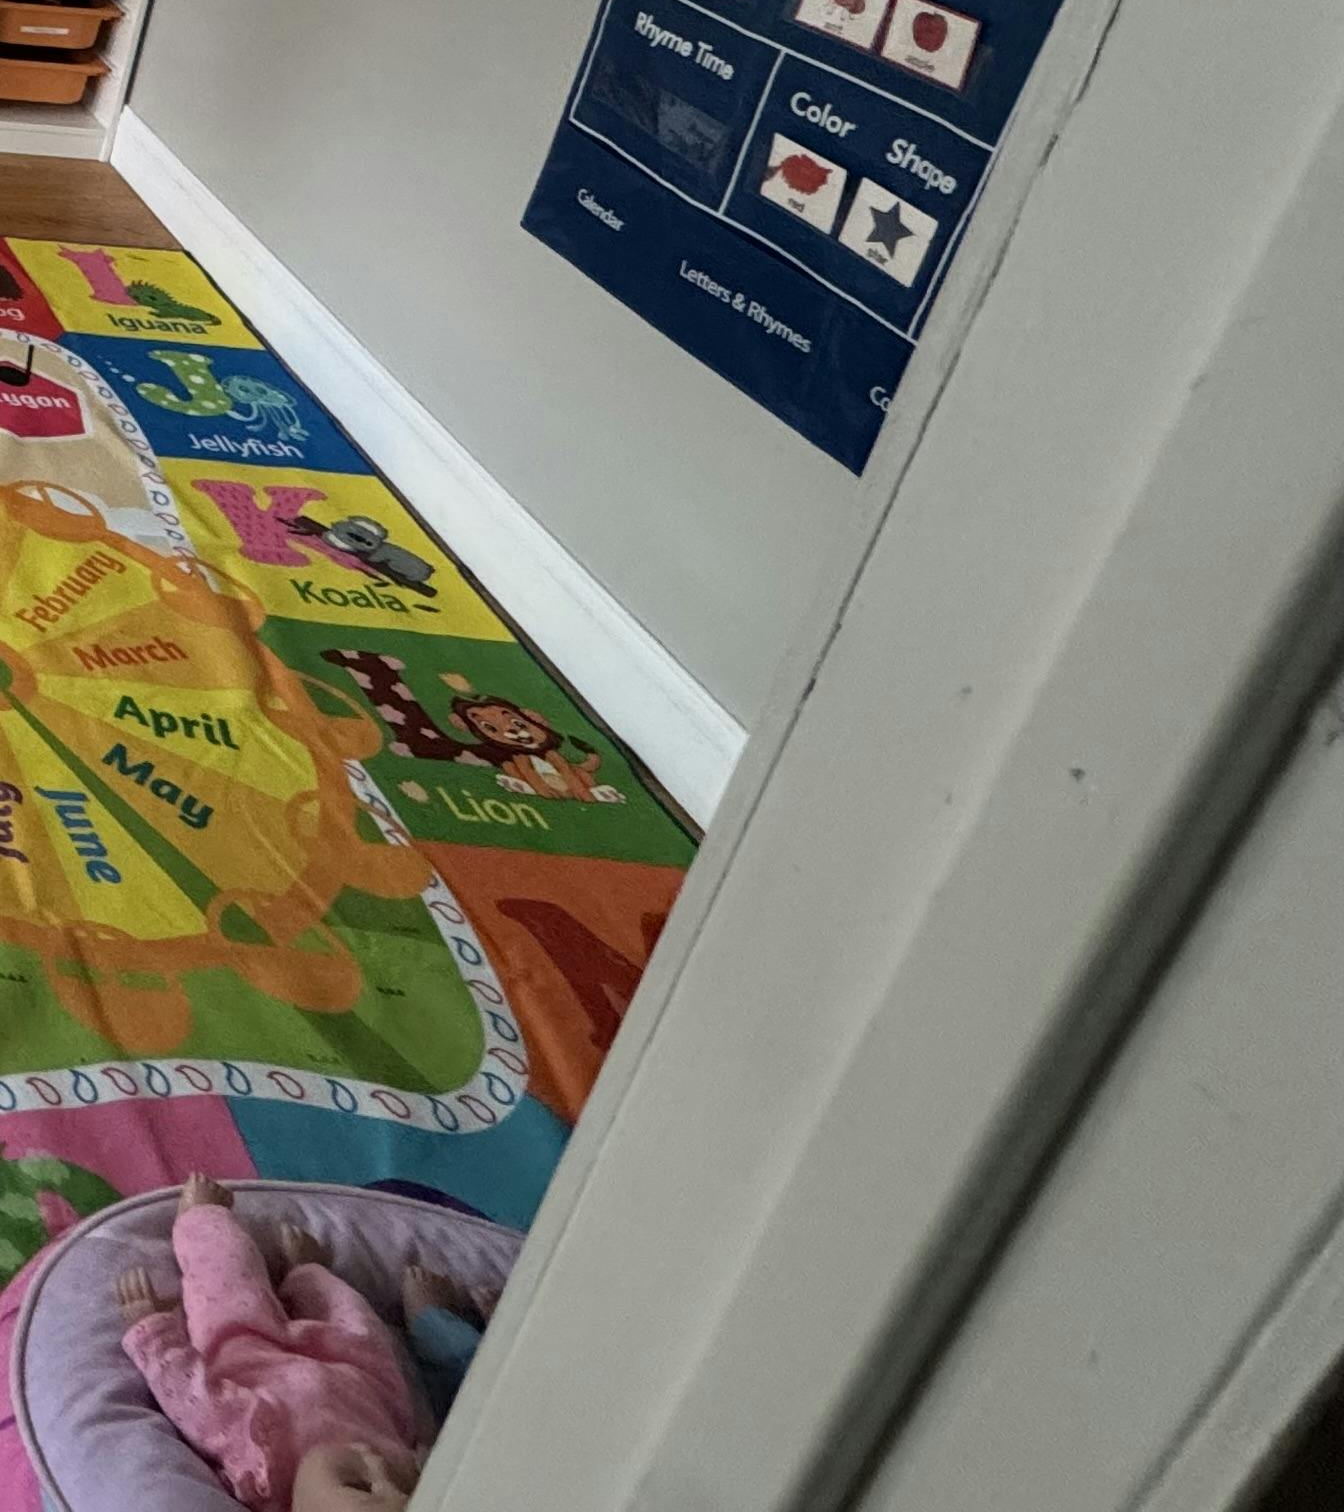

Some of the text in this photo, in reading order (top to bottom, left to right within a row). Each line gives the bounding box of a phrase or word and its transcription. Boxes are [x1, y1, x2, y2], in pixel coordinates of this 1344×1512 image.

[633, 10, 736, 82] Rhyme Time
[789, 91, 857, 138] Color
[884, 137, 958, 195] Shape
[576, 188, 625, 234] Calendar
[107, 312, 208, 335] Iguana
[678, 260, 812, 355] Letters & Rhymes
[189, 433, 304, 460] Jellyfish
[14, 549, 128, 633] February
[290, 578, 410, 615] Koala
[72, 635, 189, 672] March
[113, 694, 241, 751] April
[101, 742, 216, 830] May
[437, 788, 551, 832] Lion
[34, 785, 125, 885] June
